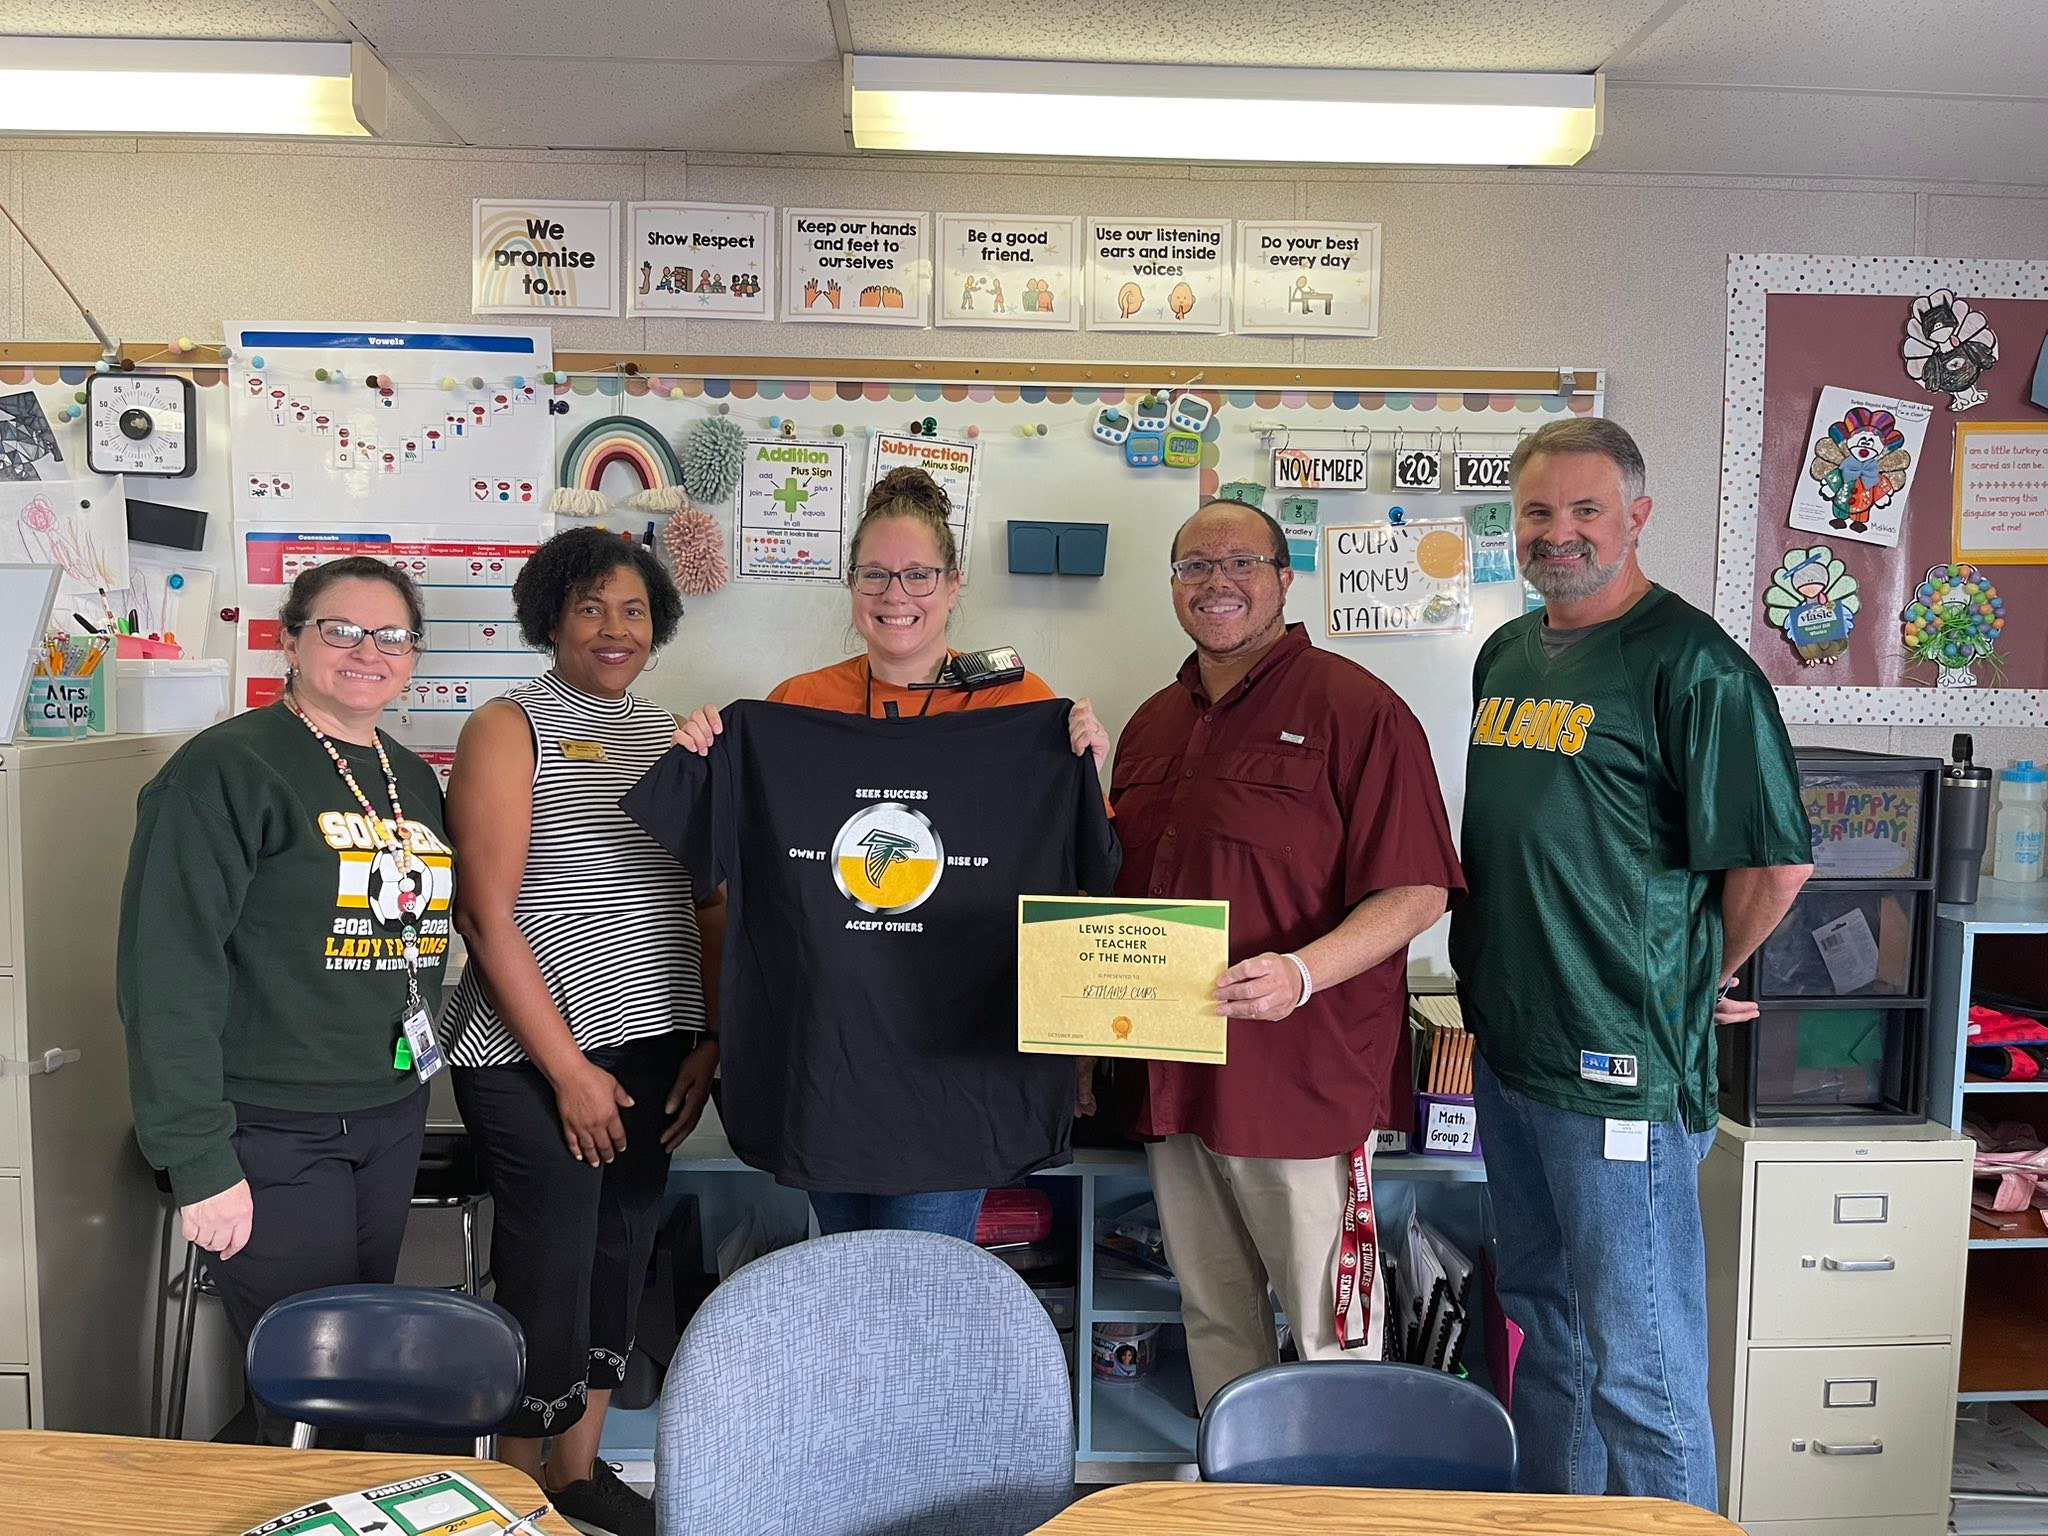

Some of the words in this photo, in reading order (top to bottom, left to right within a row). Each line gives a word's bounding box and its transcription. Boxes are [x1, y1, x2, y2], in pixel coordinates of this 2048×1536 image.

[526, 218, 564, 240] We
[797, 219, 835, 237] Keep
[840, 222, 867, 235] our
[869, 222, 917, 237] hands
[648, 231, 688, 247] Show
[693, 231, 755, 250] Respect
[967, 229, 987, 243] Be
[990, 233, 1003, 244] a
[1005, 230, 1048, 247] good
[1096, 227, 1123, 242] Use
[1126, 231, 1153, 243] our
[1156, 228, 1220, 246] listening
[1261, 235, 1282, 249] Do
[1286, 237, 1321, 252] your
[1326, 236, 1360, 251] best
[814, 237, 843, 252] and
[847, 237, 879, 253] feet
[883, 238, 900, 253] to
[494, 247, 595, 271] promise
[981, 246, 1034, 262] friend.
[1100, 246, 1135, 259] ears
[1138, 245, 1168, 259] and
[1171, 245, 1216, 260] inside
[819, 255, 894, 270] ourselves
[1132, 261, 1184, 277] voices
[1269, 255, 1316, 269] every
[1320, 253, 1350, 271] day
[522, 275, 567, 297] to...
[367, 337, 405, 346] Vowels
[113, 386, 122, 394] 55
[155, 386, 161, 395] 5
[168, 402, 177, 410] 10
[95, 419, 104, 428] 45
[100, 439, 109, 448] 40
[756, 446, 829, 464] Addition
[881, 440, 968, 463] Subtraction
[1964, 446, 1968, 455] I
[1969, 447, 1982, 455] am
[1983, 447, 1989, 455] a
[1990, 446, 2011, 455] little
[2013, 446, 2041, 456] turkey
[115, 454, 123, 463] 35
[155, 455, 164, 464] 25
[134, 460, 144, 468] 30
[1970, 460, 2000, 470] scared
[2001, 461, 2011, 470] as
[2017, 462, 2031, 470] can
[2032, 461, 2045, 470] be.
[791, 466, 810, 476] Plus
[811, 467, 833, 477] Sign
[921, 459, 948, 471] Minus
[949, 462, 970, 474] Sign
[1280, 459, 1363, 482] NOVEMBER
[1467, 459, 1511, 485] 2025
[758, 472, 773, 480] add
[749, 489, 763, 498] join
[814, 485, 828, 493] plus
[1975, 494, 1987, 503] I'm
[1988, 494, 2020, 504] wearing
[2022, 493, 2038, 503] this
[763, 509, 778, 517] sum
[802, 509, 826, 518] equals
[1295, 504, 1303, 518] ONE
[1962, 509, 1996, 519] disguise
[1998, 510, 2009, 518] so
[2010, 510, 2027, 519] you
[792, 520, 801, 528] all
[1991, 522, 2005, 532] eat
[2006, 522, 2022, 532] me!
[298, 534, 340, 542] Consonants
[767, 529, 782, 537] What
[1284, 527, 1313, 538] Bradley
[1480, 540, 1507, 548] Conner
[1340, 567, 1409, 594] MONEY
[1332, 604, 1420, 632] STATION
[47, 684, 88, 701] Mrs.
[855, 788, 882, 800] SEEK
[883, 789, 929, 801] SUCCESS
[1826, 790, 1897, 816] HAPPY
[1811, 819, 1907, 848] BIRTHDAY!
[788, 847, 815, 860] OWN
[816, 850, 827, 861] IT
[947, 855, 972, 867] RISE
[973, 856, 989, 867] UP
[333, 918, 373, 935] 2021
[420, 919, 449, 935] 2022
[844, 920, 883, 932] ACCEPT
[884, 921, 924, 933] OTHERS
[1079, 924, 1115, 935] LEWIS
[1118, 925, 1168, 936] SCHOOL
[325, 937, 381, 958] LADY
[1095, 938, 1147, 950] TEACHER
[325, 958, 372, 971] LEWIS
[1079, 951, 1095, 962] OF
[1099, 952, 1120, 963] THE
[1122, 953, 1167, 965] MONTH
[1083, 985, 1128, 1000] BETHANY
[1047, 1031, 1071, 1039] OCTOBER
[1613, 1059, 1632, 1075] XL
[1438, 1111, 1465, 1125] Math
[1431, 1129, 1460, 1147] Group
[1462, 1131, 1469, 1144] 2
[1354, 1157, 1368, 1202] SEMINOLES
[1361, 1242, 1373, 1287] SEMINOLES
[369, 1473, 448, 1499] FINISHED:
[251, 1522, 278, 1535] TO
[281, 1508, 316, 1524] DO:
[444, 1520, 468, 1533] 2nd
